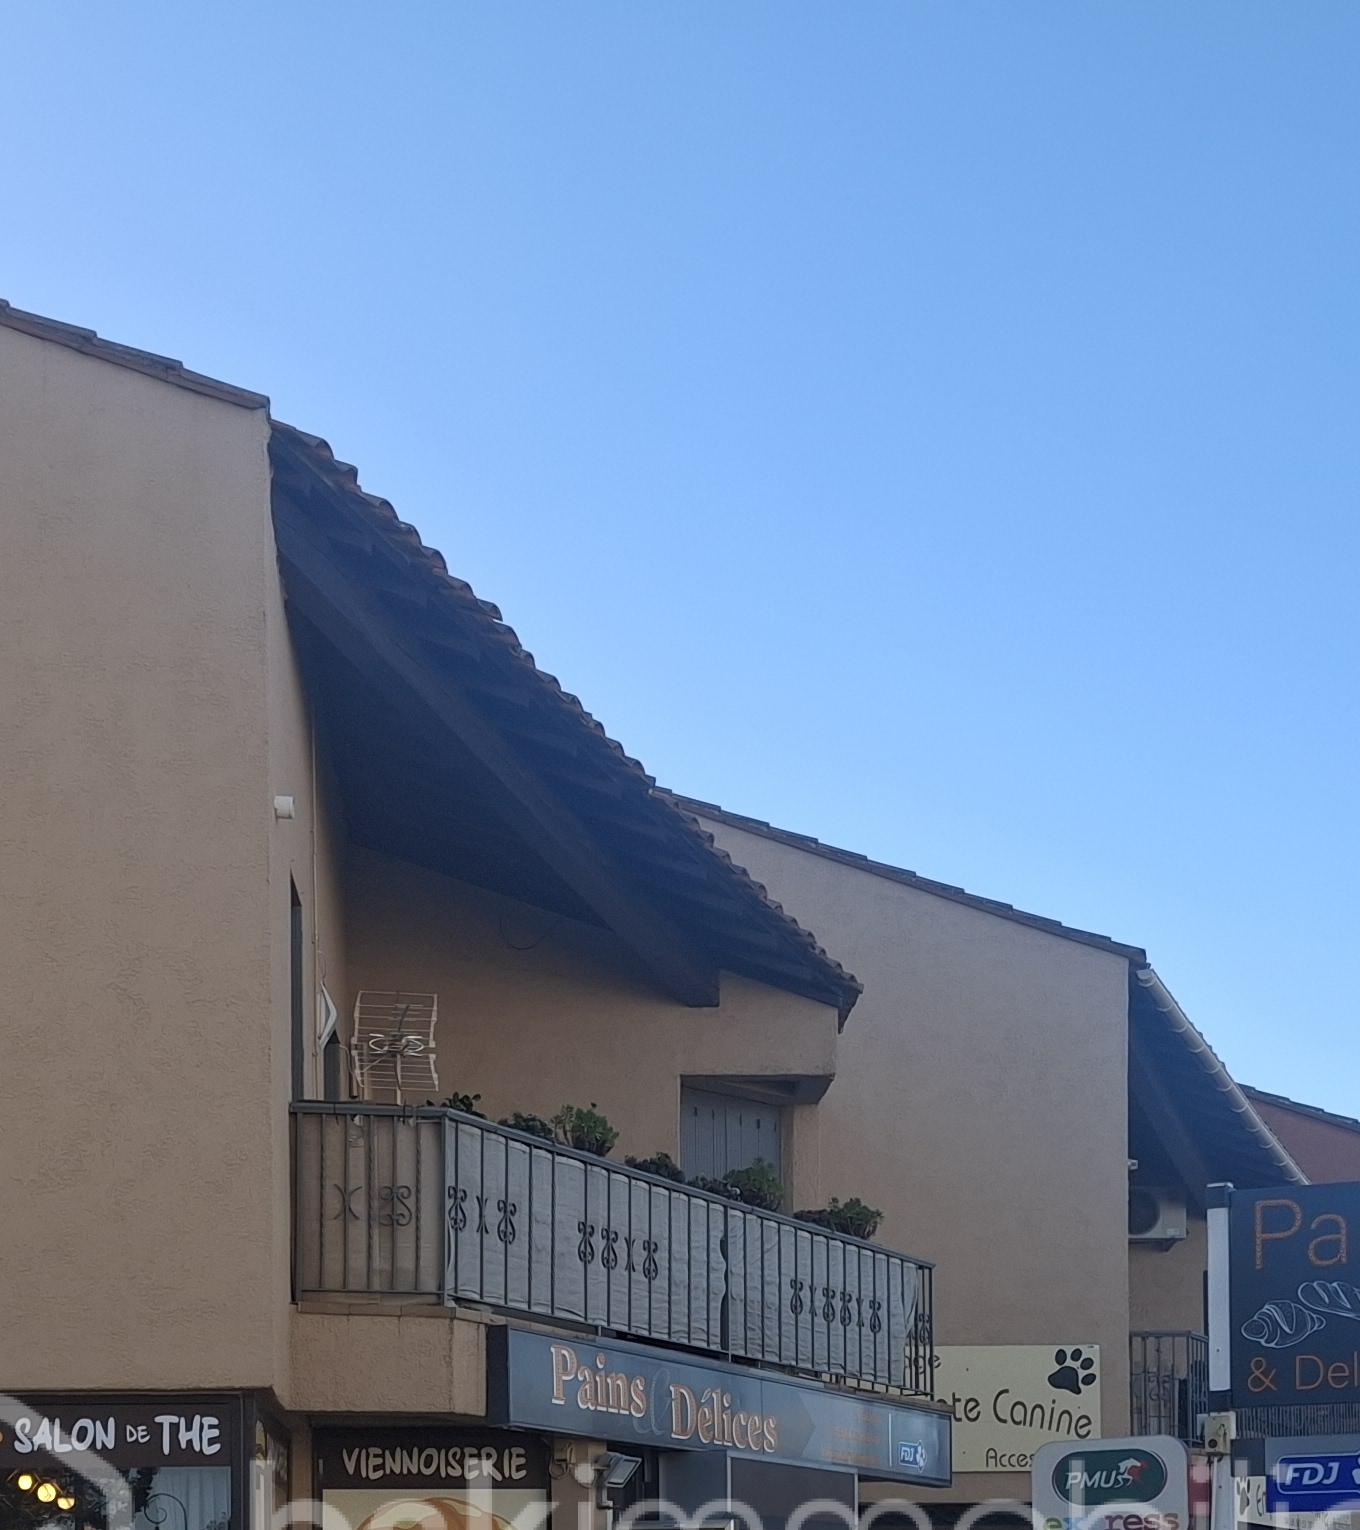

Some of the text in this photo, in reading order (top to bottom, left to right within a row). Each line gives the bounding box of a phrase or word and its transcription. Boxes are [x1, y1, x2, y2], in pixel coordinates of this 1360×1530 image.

[1247, 1356, 1277, 1392] &
[550, 1344, 647, 1418] Pains
[670, 1384, 778, 1453] Délices
[993, 1388, 1092, 1439] Canine
[13, 1416, 116, 1453] SALON
[125, 1424, 151, 1444] DE
[154, 1414, 221, 1456] THE
[342, 1447, 527, 1481] VIENNOISERIE
[900, 1446, 915, 1463] FDJ
[1065, 1470, 1116, 1490] PMU
[1285, 1462, 1340, 1486] FDJ
